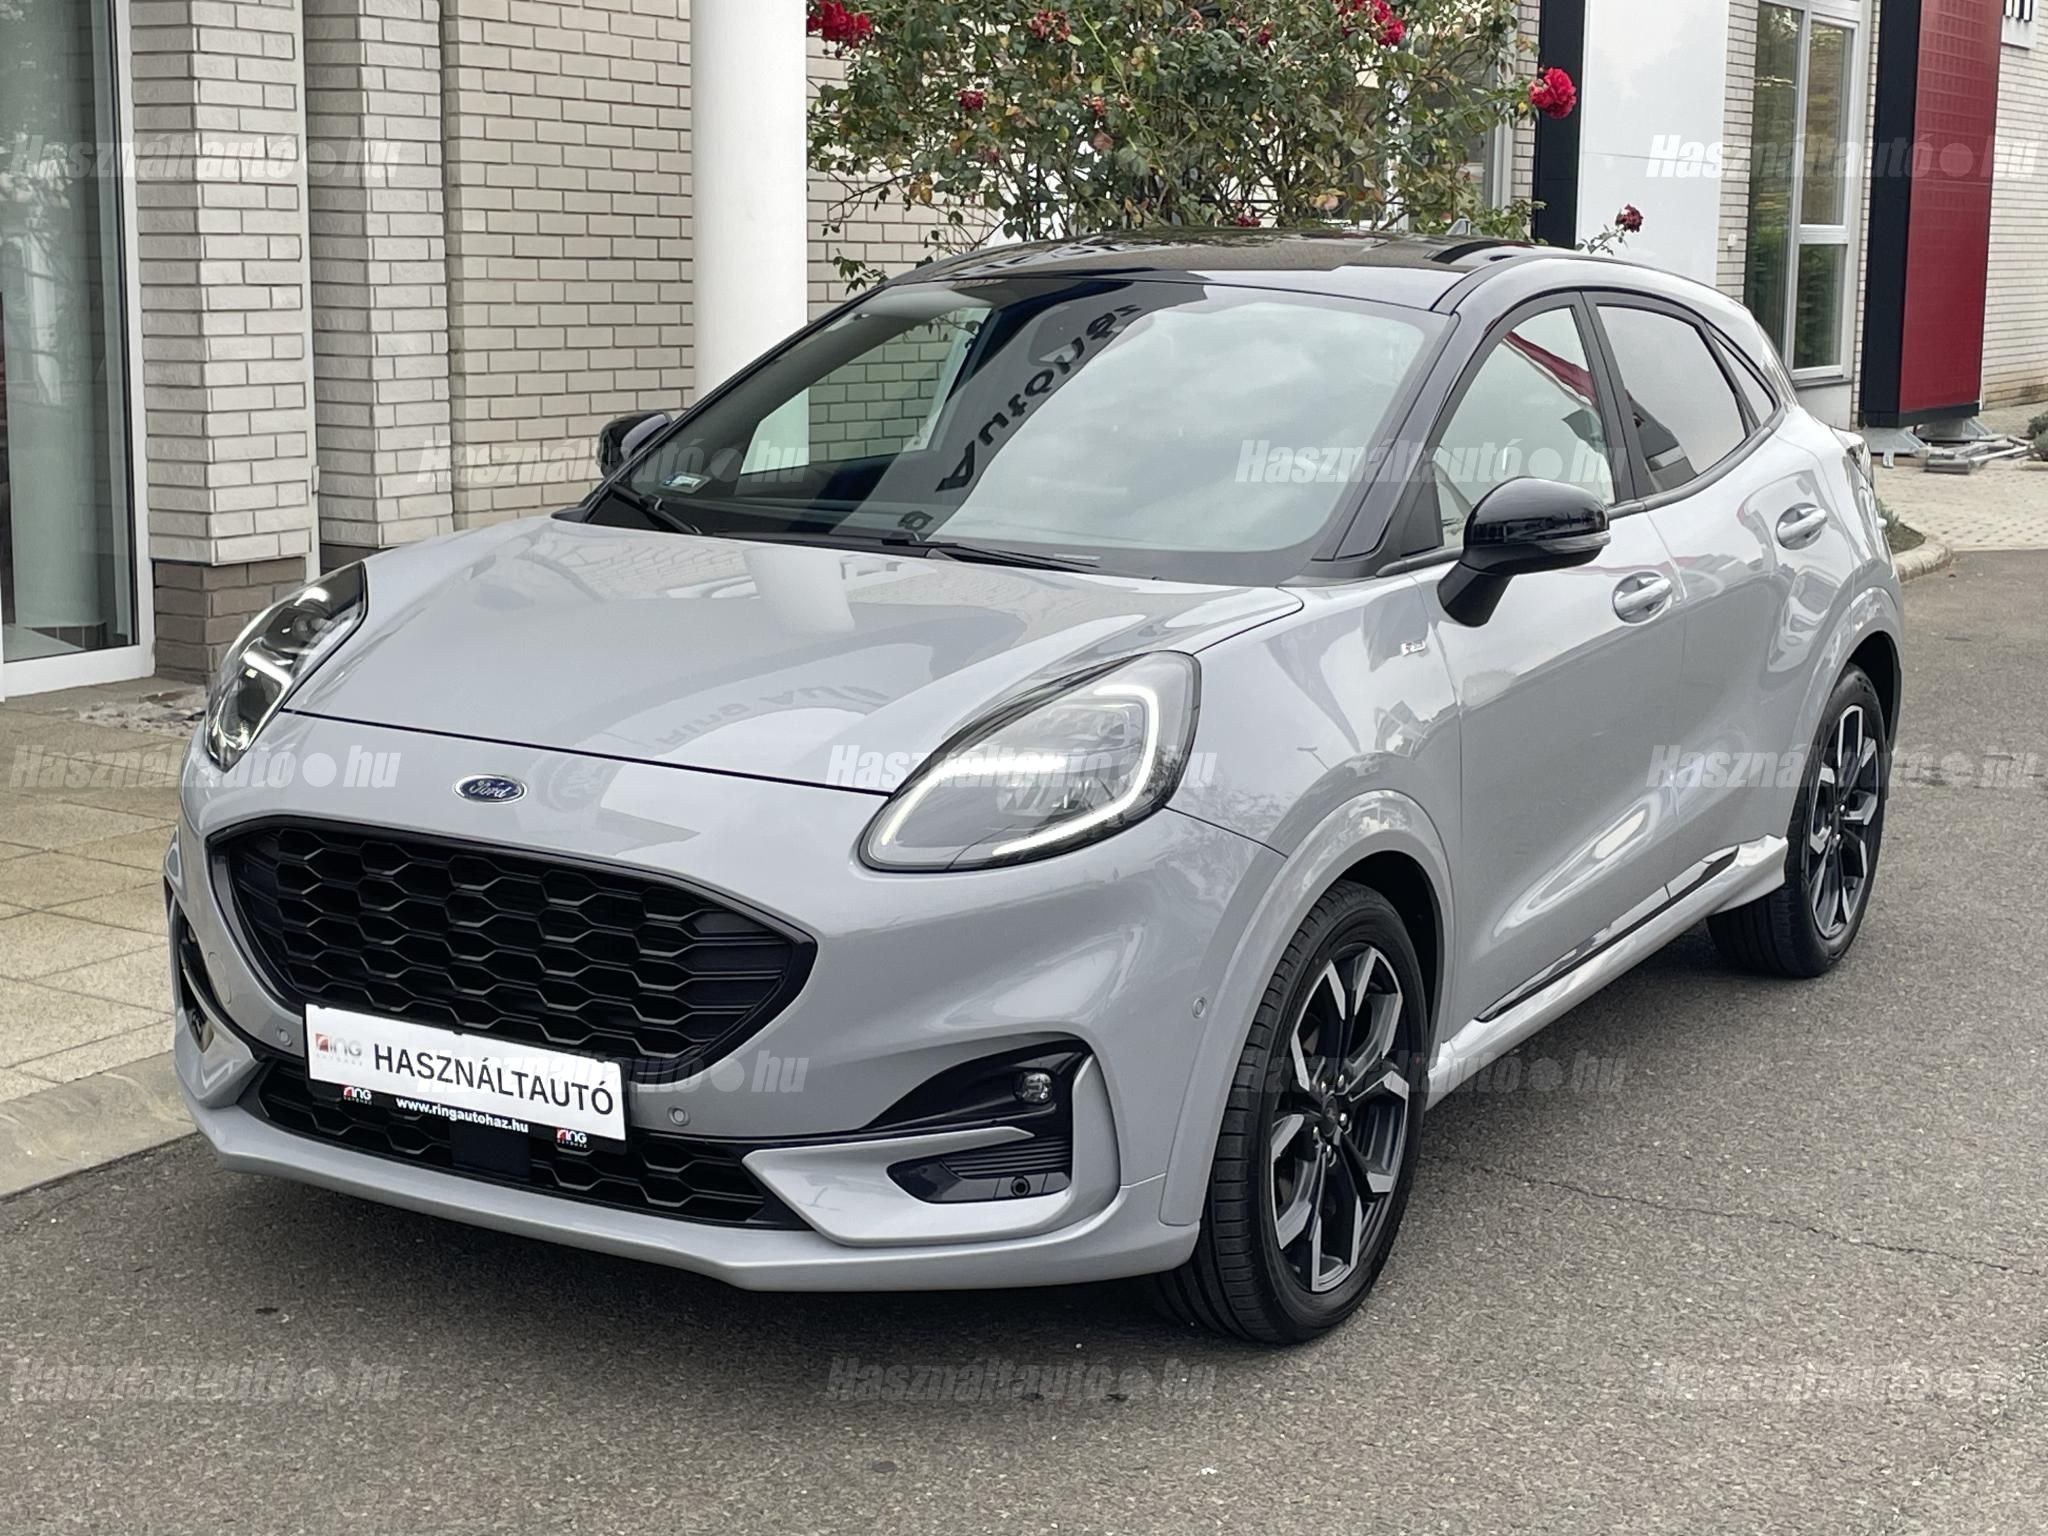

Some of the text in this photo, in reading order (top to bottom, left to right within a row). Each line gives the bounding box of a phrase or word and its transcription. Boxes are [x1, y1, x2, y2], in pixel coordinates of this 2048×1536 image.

[469, 780, 512, 798] Ford
[374, 1043, 614, 1115] HASZNÁLTAUTÓ
[396, 1098, 529, 1133] www.ringautohaz.hu
